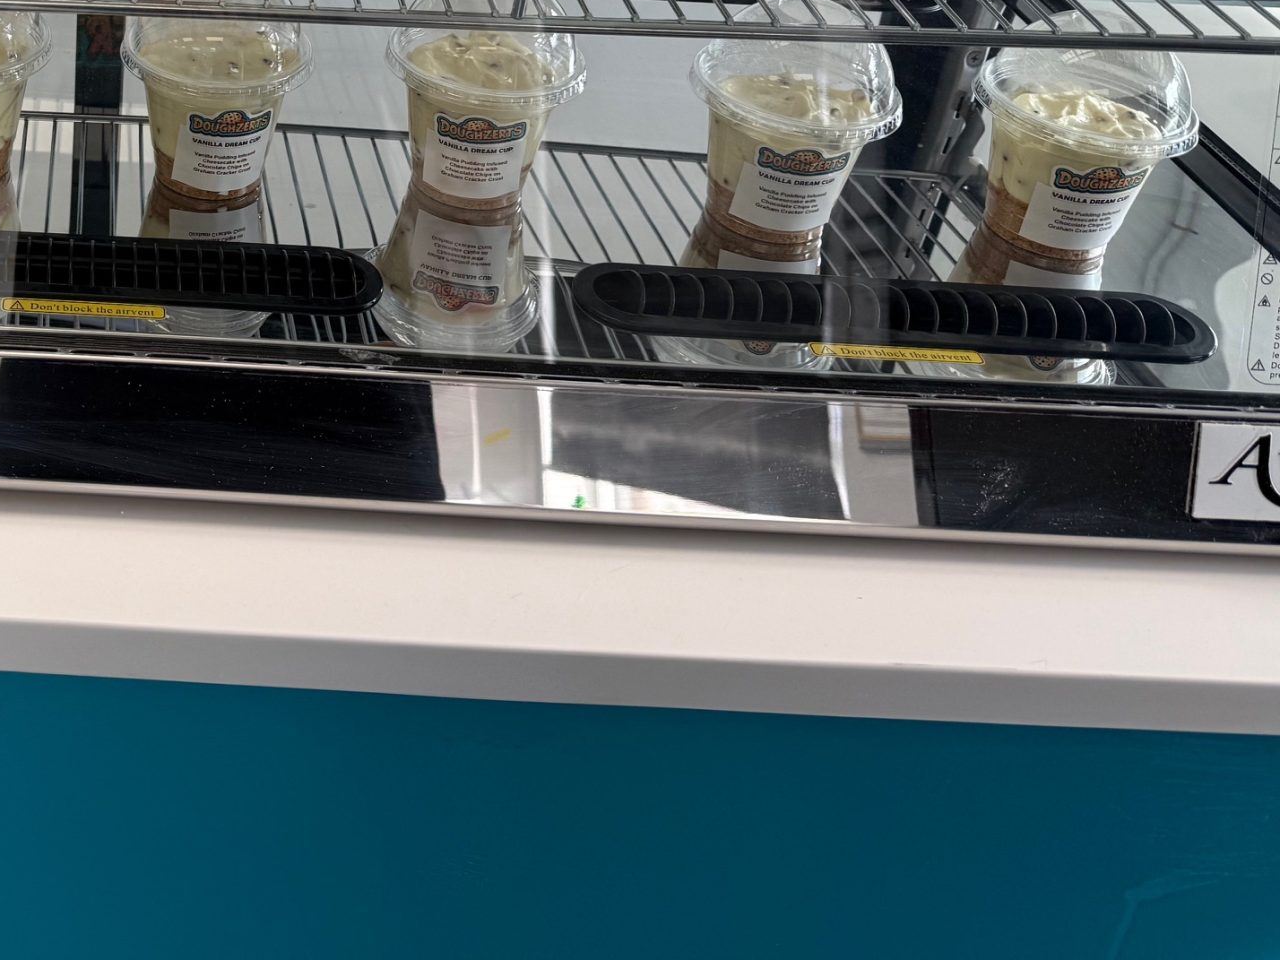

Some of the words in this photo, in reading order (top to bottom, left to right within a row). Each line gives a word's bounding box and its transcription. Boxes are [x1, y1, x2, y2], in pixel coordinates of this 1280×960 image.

[440, 119, 523, 139] DOUGHZERTS
[192, 137, 223, 148] VANILLA
[249, 136, 262, 144] CUP
[438, 138, 469, 152] VANILLA
[1052, 192, 1088, 204] VANILLA
[1116, 195, 1130, 203] CUP
[30, 302, 60, 311] Don't
[62, 303, 94, 313] block
[96, 305, 113, 314] the
[114, 308, 156, 317] airvent
[840, 347, 873, 356] Don't
[874, 349, 907, 359] block
[909, 350, 929, 359] the
[930, 353, 974, 361] airvent
